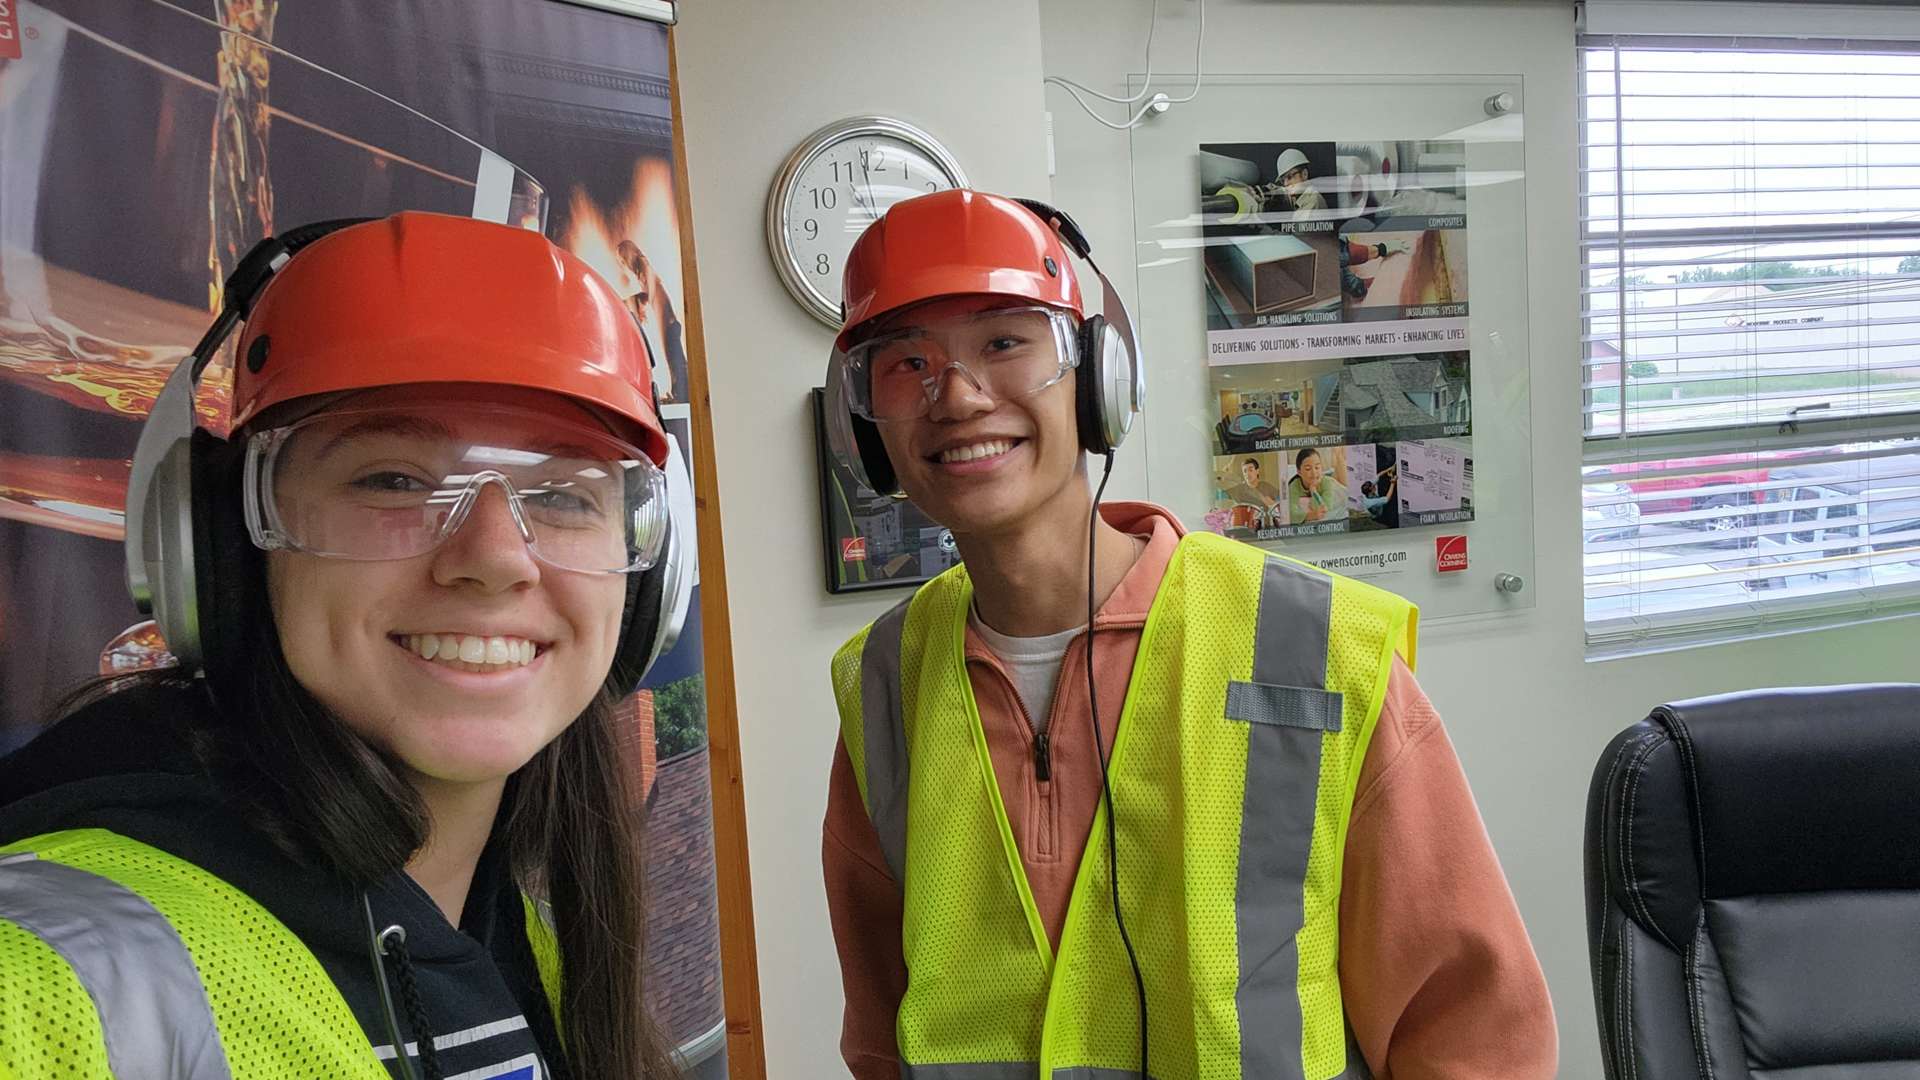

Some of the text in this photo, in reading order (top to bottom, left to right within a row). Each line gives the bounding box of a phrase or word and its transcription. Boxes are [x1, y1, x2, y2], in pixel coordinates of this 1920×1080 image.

[862, 150, 887, 172] 12
[829, 161, 853, 182] 11
[809, 187, 837, 210] 10
[804, 218, 818, 240] 9
[1281, 221, 1334, 233] PIPE INSULATION
[1428, 217, 1464, 227] COMPOSITES
[816, 253, 830, 275] 8
[1256, 312, 1337, 325] AIR HANDLING SOLUTIONS
[1405, 304, 1466, 317] INSULATING SYSTEMS
[1212, 328, 1465, 354] DELIVERING SOLUTIONS TRANSFORMING MARKETS ENHANCING LIVES
[1255, 439, 1286, 450] BASEMENT
[1288, 437, 1319, 448] FINISHING
[1420, 510, 1471, 524] FOAM INSULATION
[1257, 522, 1344, 539] RESIDENTIAL NOISE CONTROL
[1308, 550, 1407, 569] w.owenscorning.com
